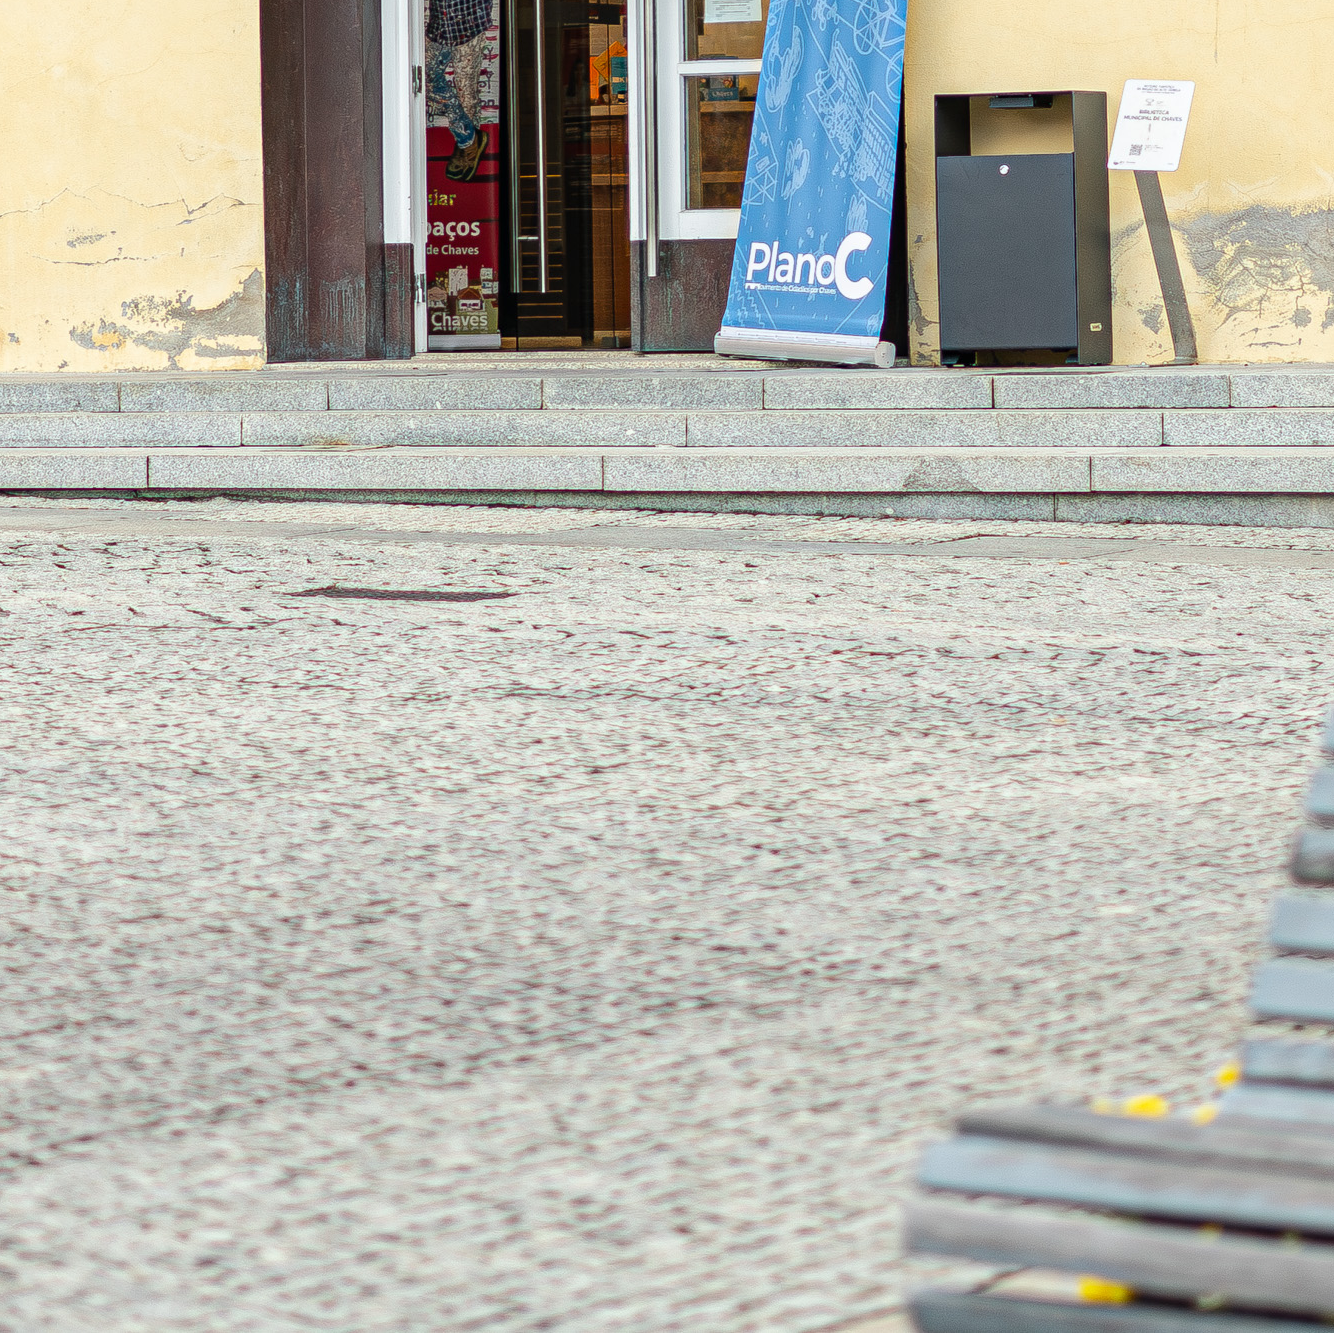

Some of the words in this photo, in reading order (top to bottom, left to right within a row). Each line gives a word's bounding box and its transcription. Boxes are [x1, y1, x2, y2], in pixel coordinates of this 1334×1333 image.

[427, 244, 439, 255] de
[441, 244, 479, 255] Chaves
[431, 312, 488, 327] Chaves
